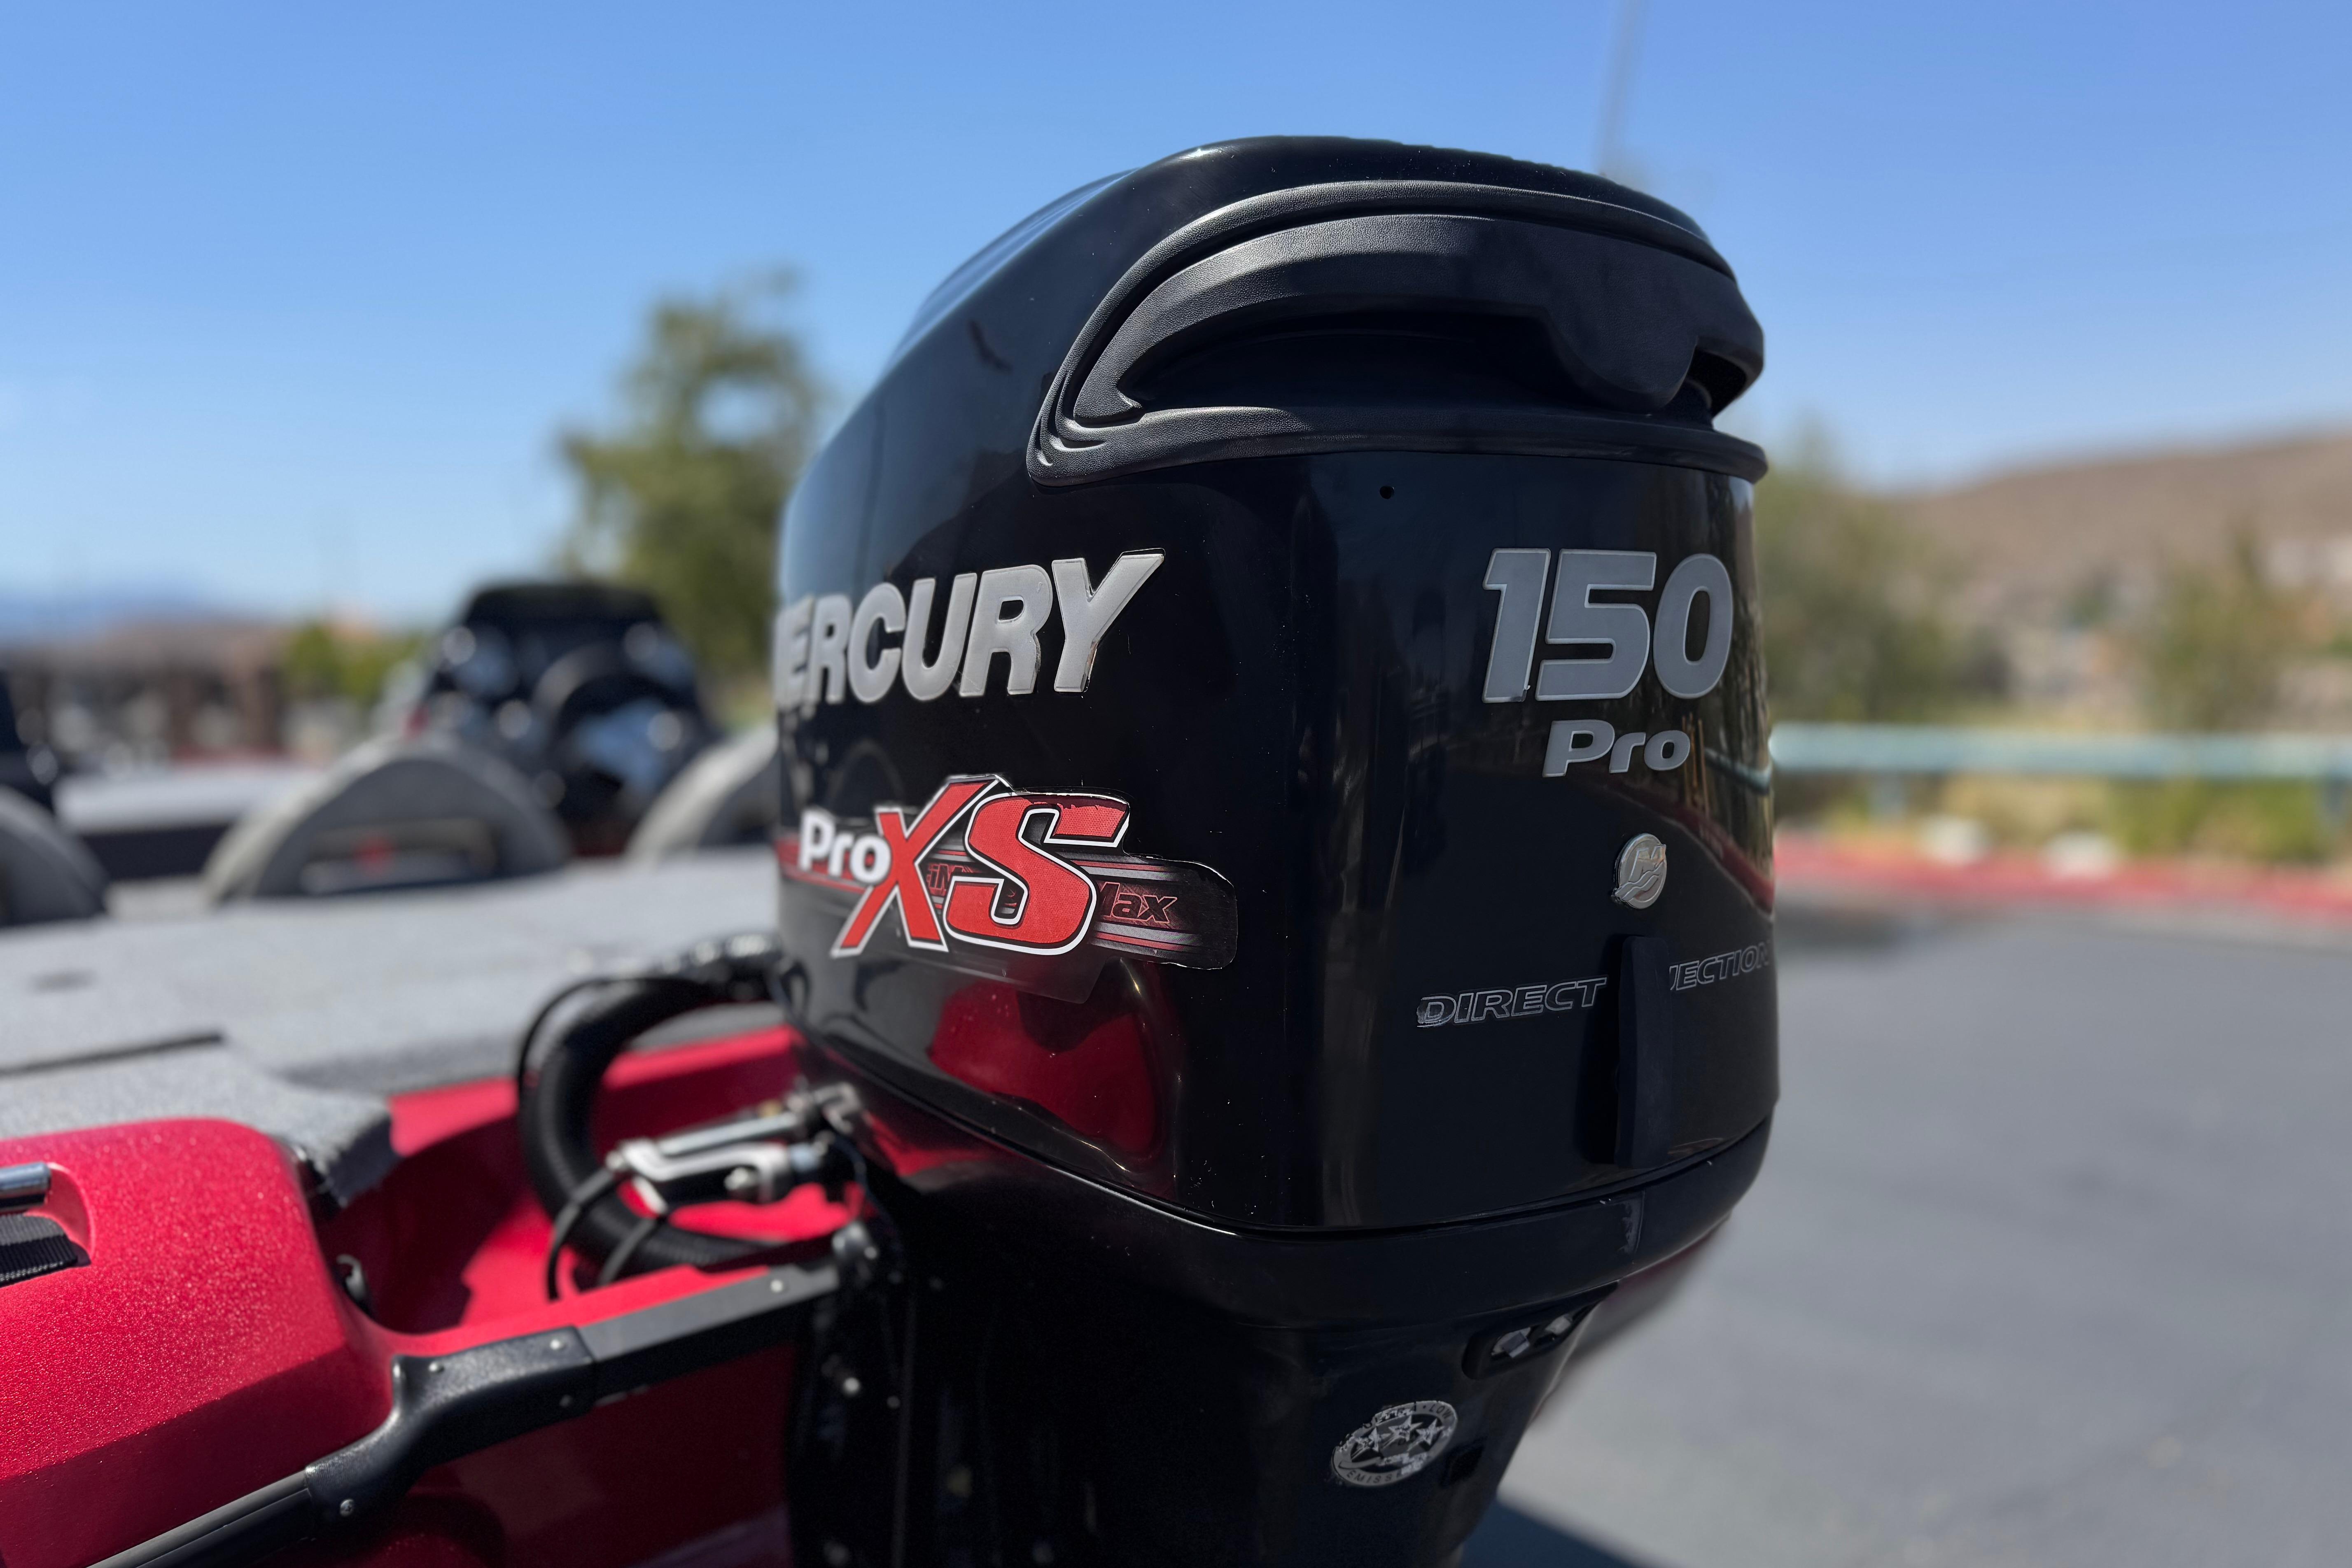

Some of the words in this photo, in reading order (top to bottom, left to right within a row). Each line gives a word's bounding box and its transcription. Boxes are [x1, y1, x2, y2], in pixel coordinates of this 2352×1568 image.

[775, 548, 1165, 707] ERCURY
[1482, 548, 1734, 703] 150
[1542, 719, 1690, 777] Pro
[1416, 976, 1608, 1028] DIRECT
